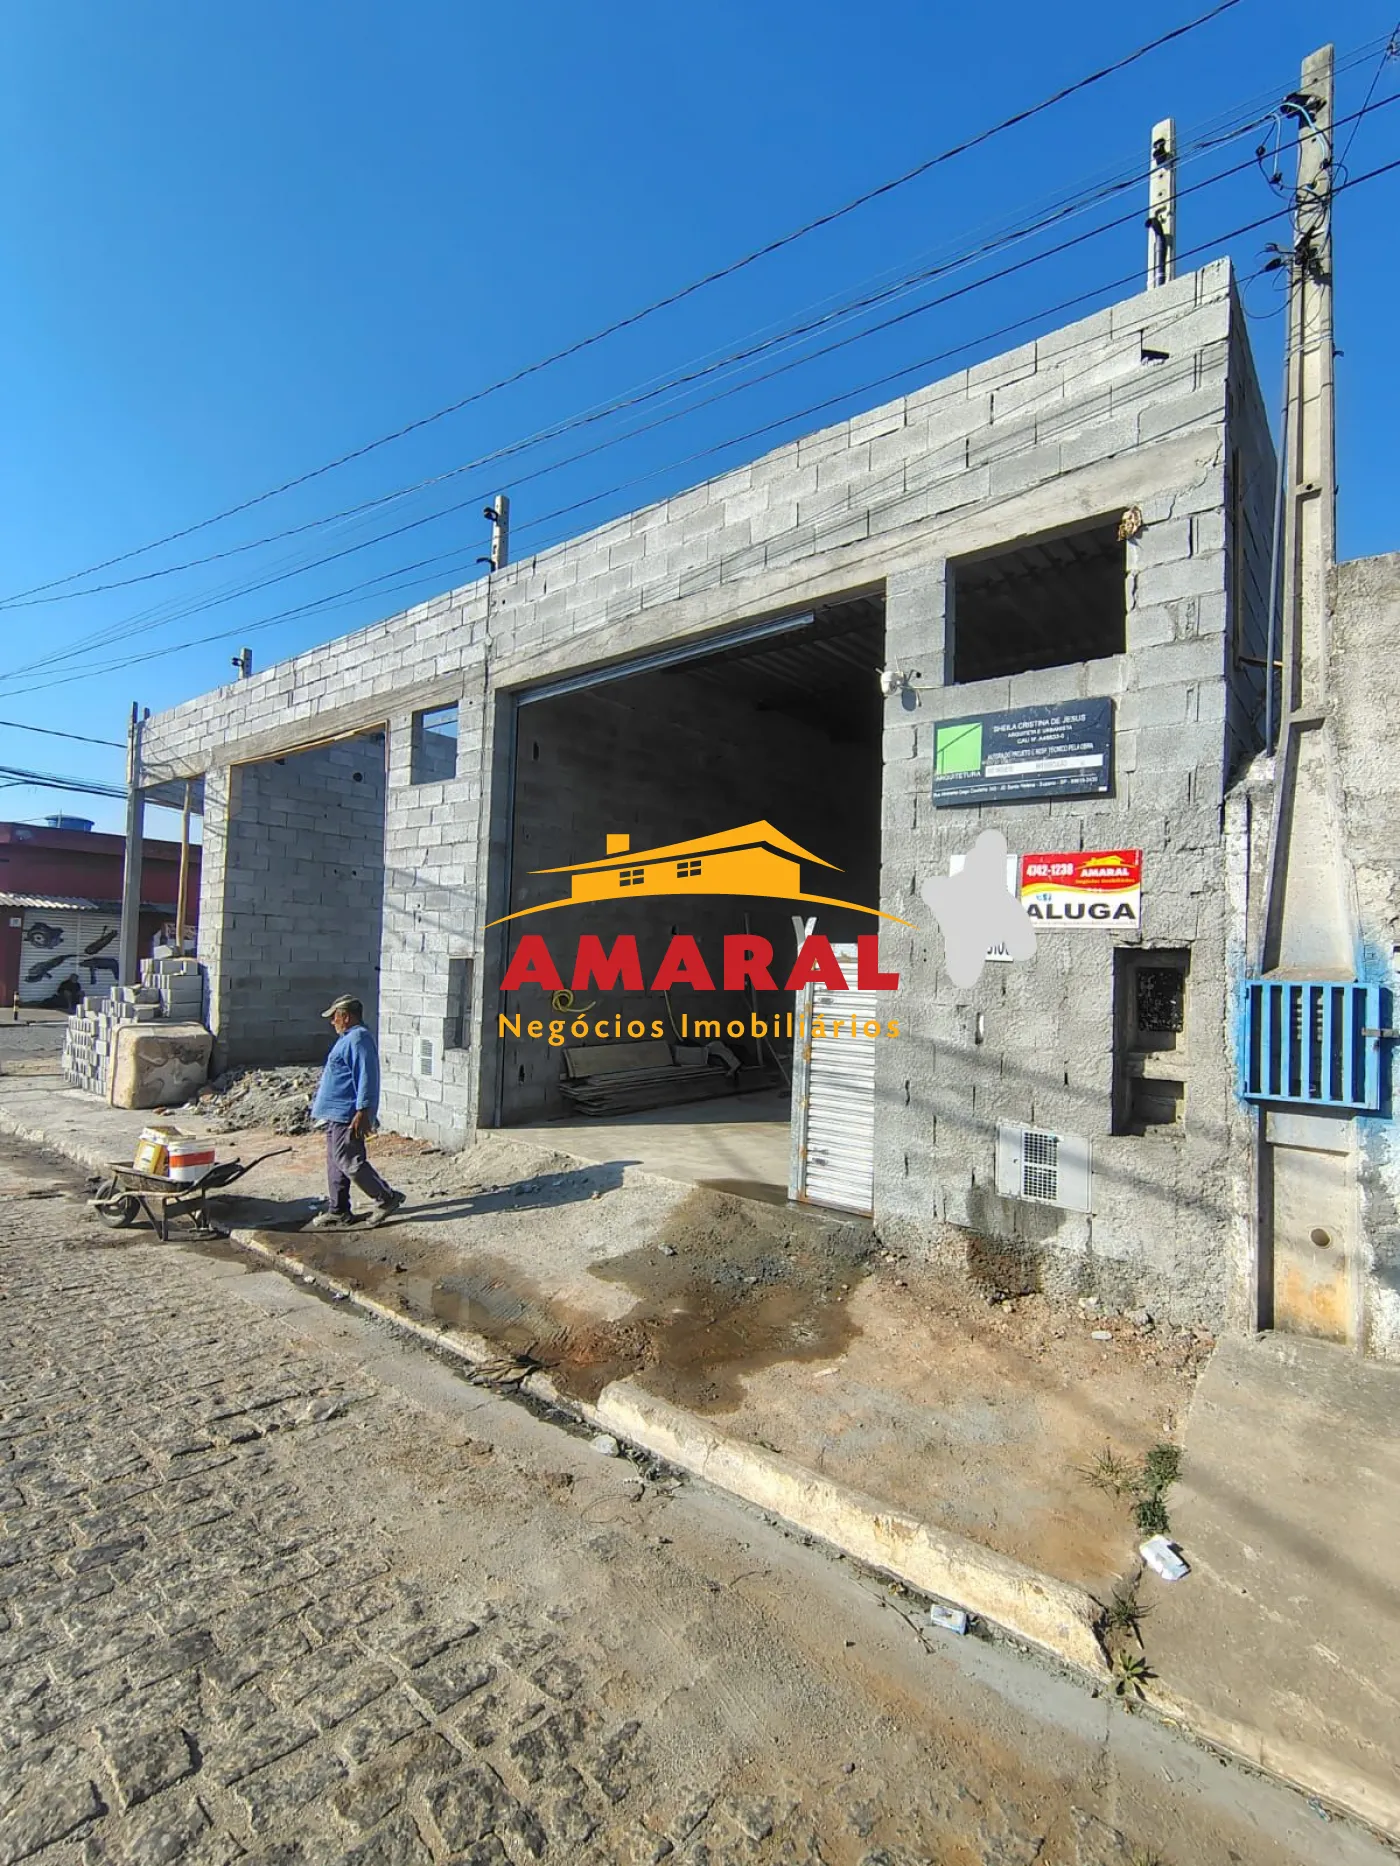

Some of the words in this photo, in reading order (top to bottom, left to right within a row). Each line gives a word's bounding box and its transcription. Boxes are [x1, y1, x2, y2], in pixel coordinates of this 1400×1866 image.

[1017, 718, 1050, 730] CRISTINA
[1050, 717, 1060, 725] DE
[1062, 713, 1086, 724] JESUS
[1026, 863, 1074, 877] 4742-1238
[1080, 868, 1130, 877] AMARAL
[1027, 903, 1136, 919] ALUGA
